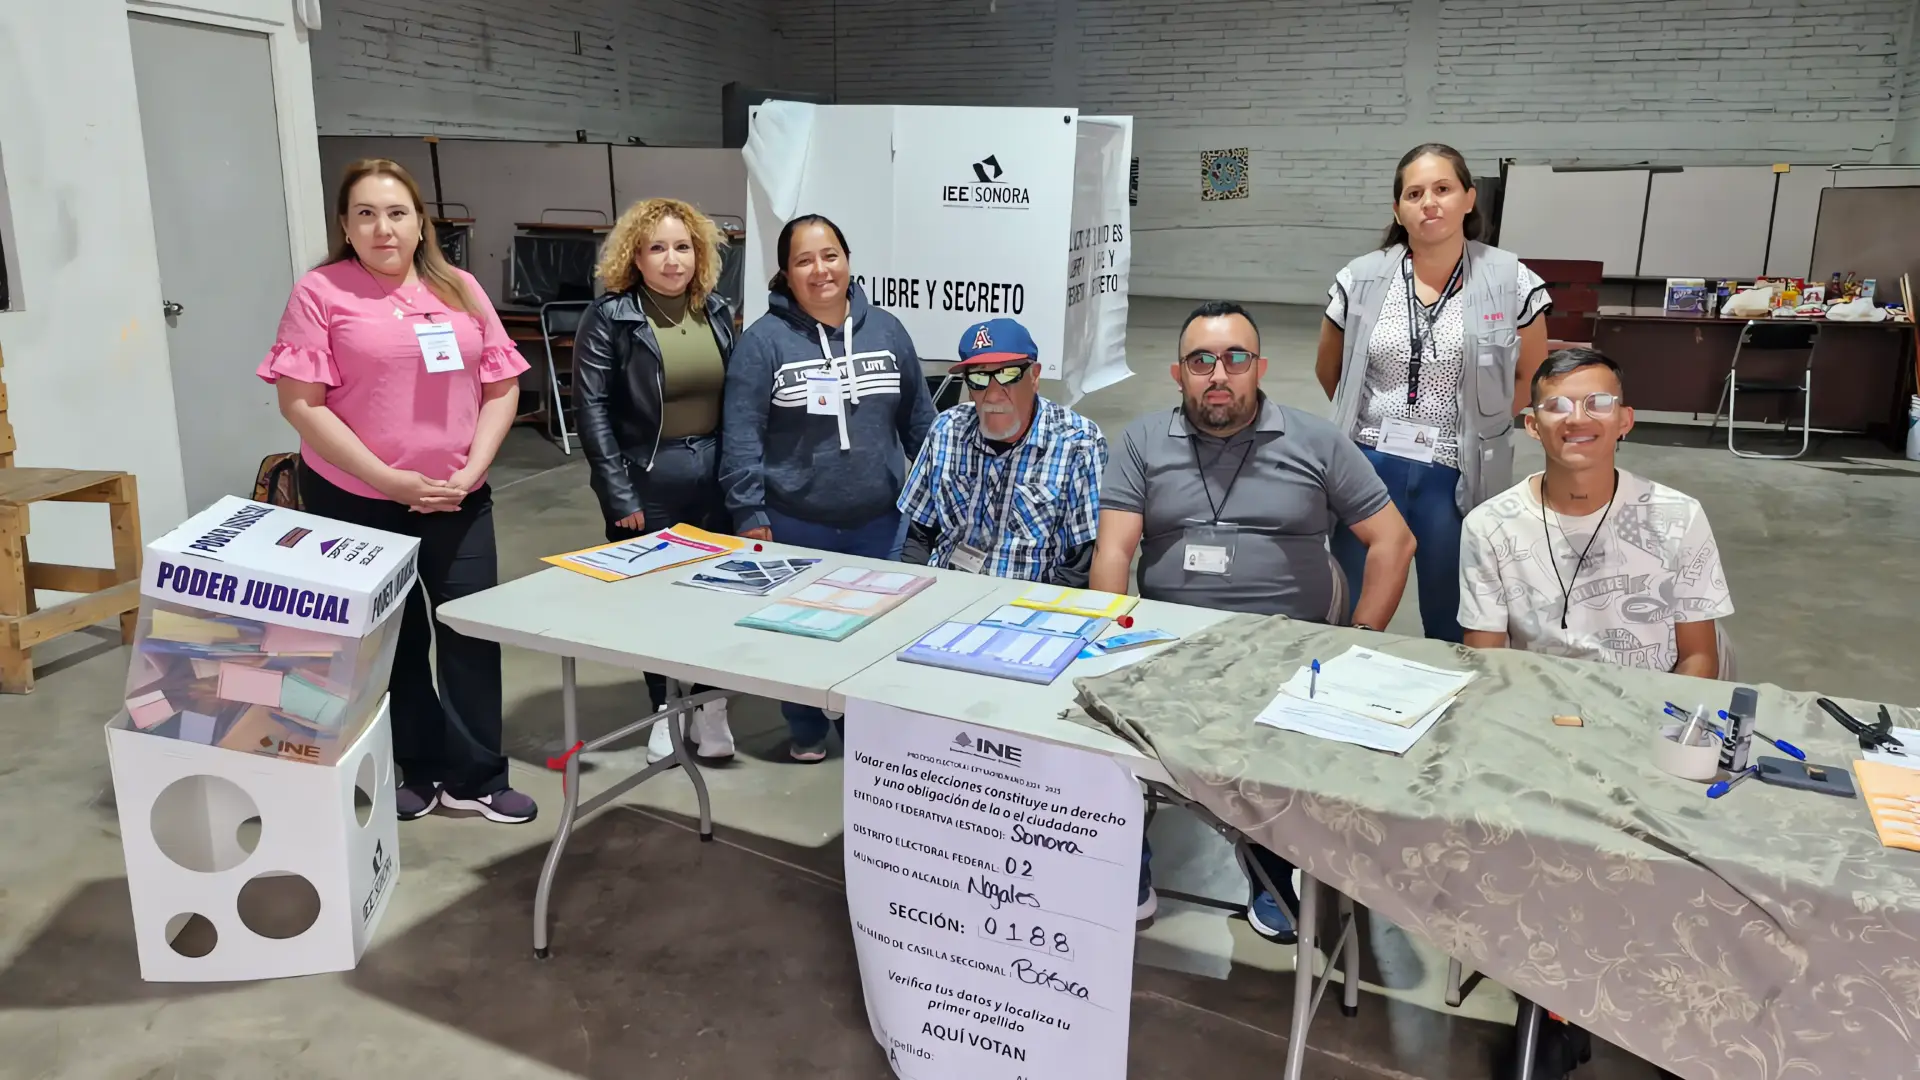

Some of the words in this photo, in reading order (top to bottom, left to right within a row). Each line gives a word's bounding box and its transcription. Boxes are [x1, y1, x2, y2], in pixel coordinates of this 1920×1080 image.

[942, 185, 970, 202] IEE
[974, 186, 1030, 205] SONORA
[872, 276, 920, 309] LIBRE
[925, 279, 937, 310] Y
[942, 280, 1025, 315] SECRETO
[156, 561, 238, 605] PODER
[240, 579, 350, 625] JUDICIAL
[277, 740, 321, 758] INE
[976, 737, 1022, 763] INE
[855, 750, 884, 768] Votar
[885, 762, 900, 774] en
[901, 764, 918, 778] las
[920, 770, 983, 794] elecciones
[984, 786, 1048, 811] constituye
[1051, 803, 1068, 815] un
[1070, 806, 1127, 827] derecho
[873, 775, 882, 787] y
[882, 778, 905, 791] una
[906, 784, 970, 808] obligación
[971, 799, 988, 813] de
[989, 802, 1001, 816] la
[1002, 809, 1011, 819] o
[1013, 811, 1025, 822] el
[1026, 814, 1099, 838] ciudadano
[853, 823, 893, 844] DISTRITO
[895, 837, 950, 860] ELECTORAL
[1010, 823, 1084, 855] Sonora
[853, 850, 900, 873] MUNICIPIO
[902, 867, 910, 877] O
[967, 874, 1041, 911] Nogales
[889, 902, 965, 934] SECCIÓN:
[907, 944, 948, 961] CASILLA
[1011, 958, 1090, 1000] Básica
[887, 969, 932, 991] Verifica
[935, 983, 954, 997] tus
[956, 989, 992, 1007] datos
[994, 1001, 1003, 1013] y
[1004, 1001, 1055, 1026] localiza
[1057, 1018, 1071, 1030] tu
[927, 999, 971, 1017] primer
[973, 1011, 1025, 1033] apellido
[921, 1021, 965, 1044] AQUÍ
[968, 1032, 1027, 1062] VOTAN
